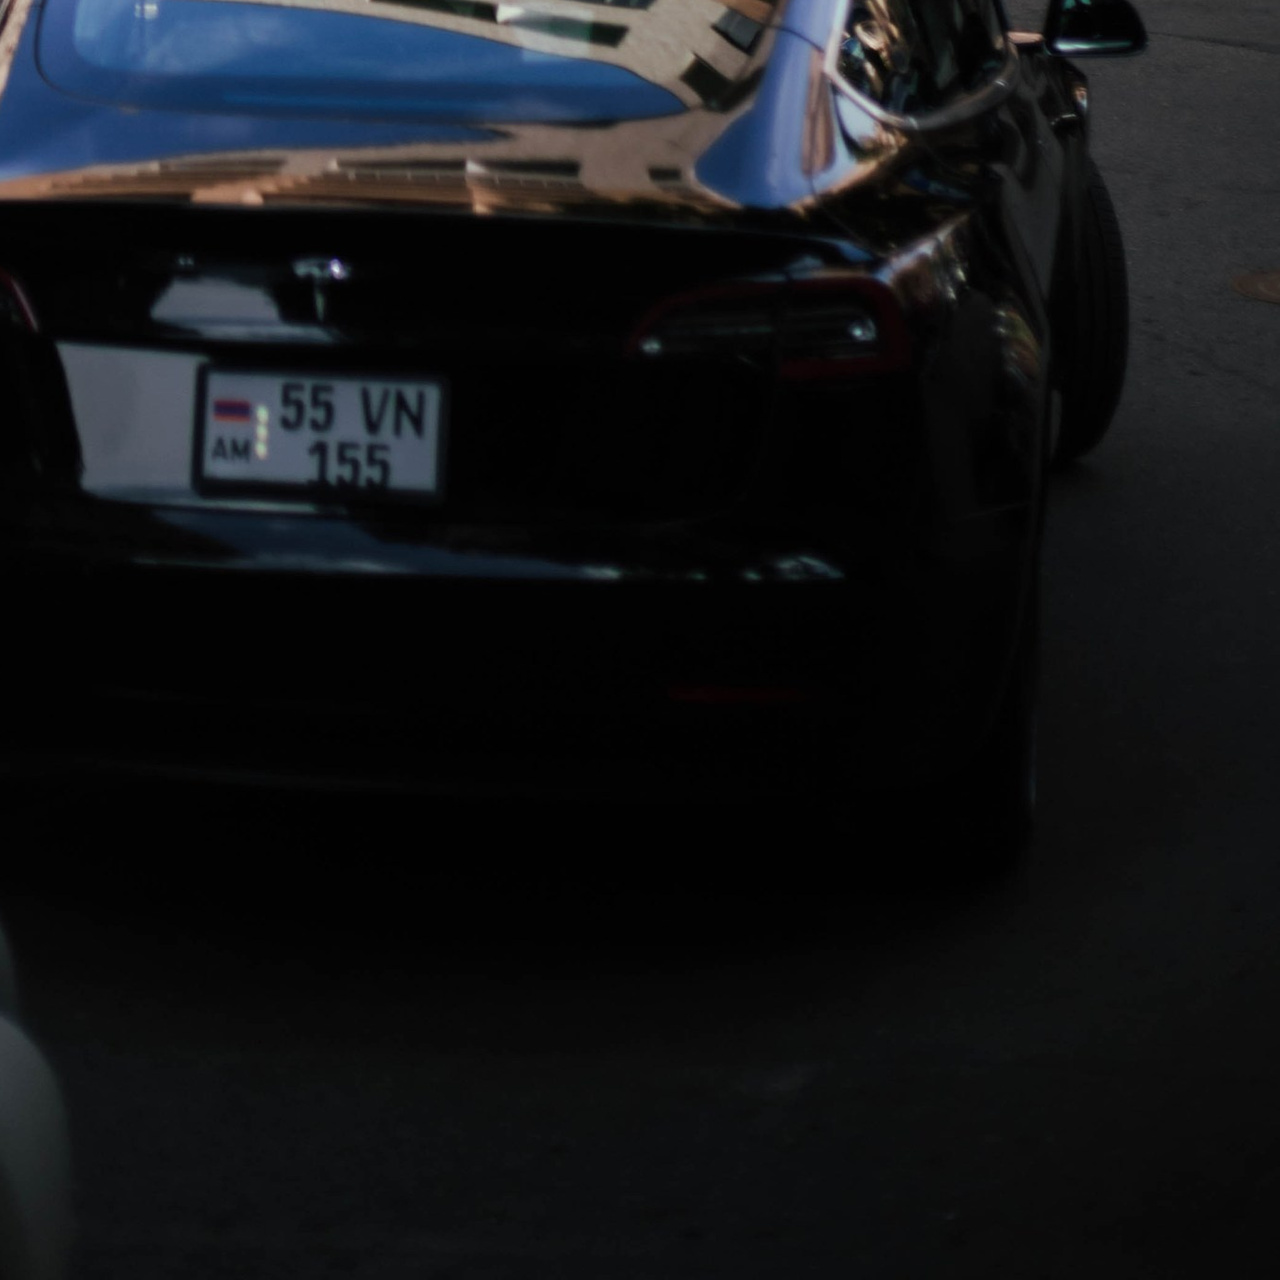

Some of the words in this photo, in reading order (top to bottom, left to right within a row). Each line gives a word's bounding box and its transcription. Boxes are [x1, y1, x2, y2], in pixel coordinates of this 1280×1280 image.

[280, 382, 335, 432] 55
[361, 387, 425, 438] VN
[212, 437, 251, 462] AM
[308, 440, 390, 487] 155
